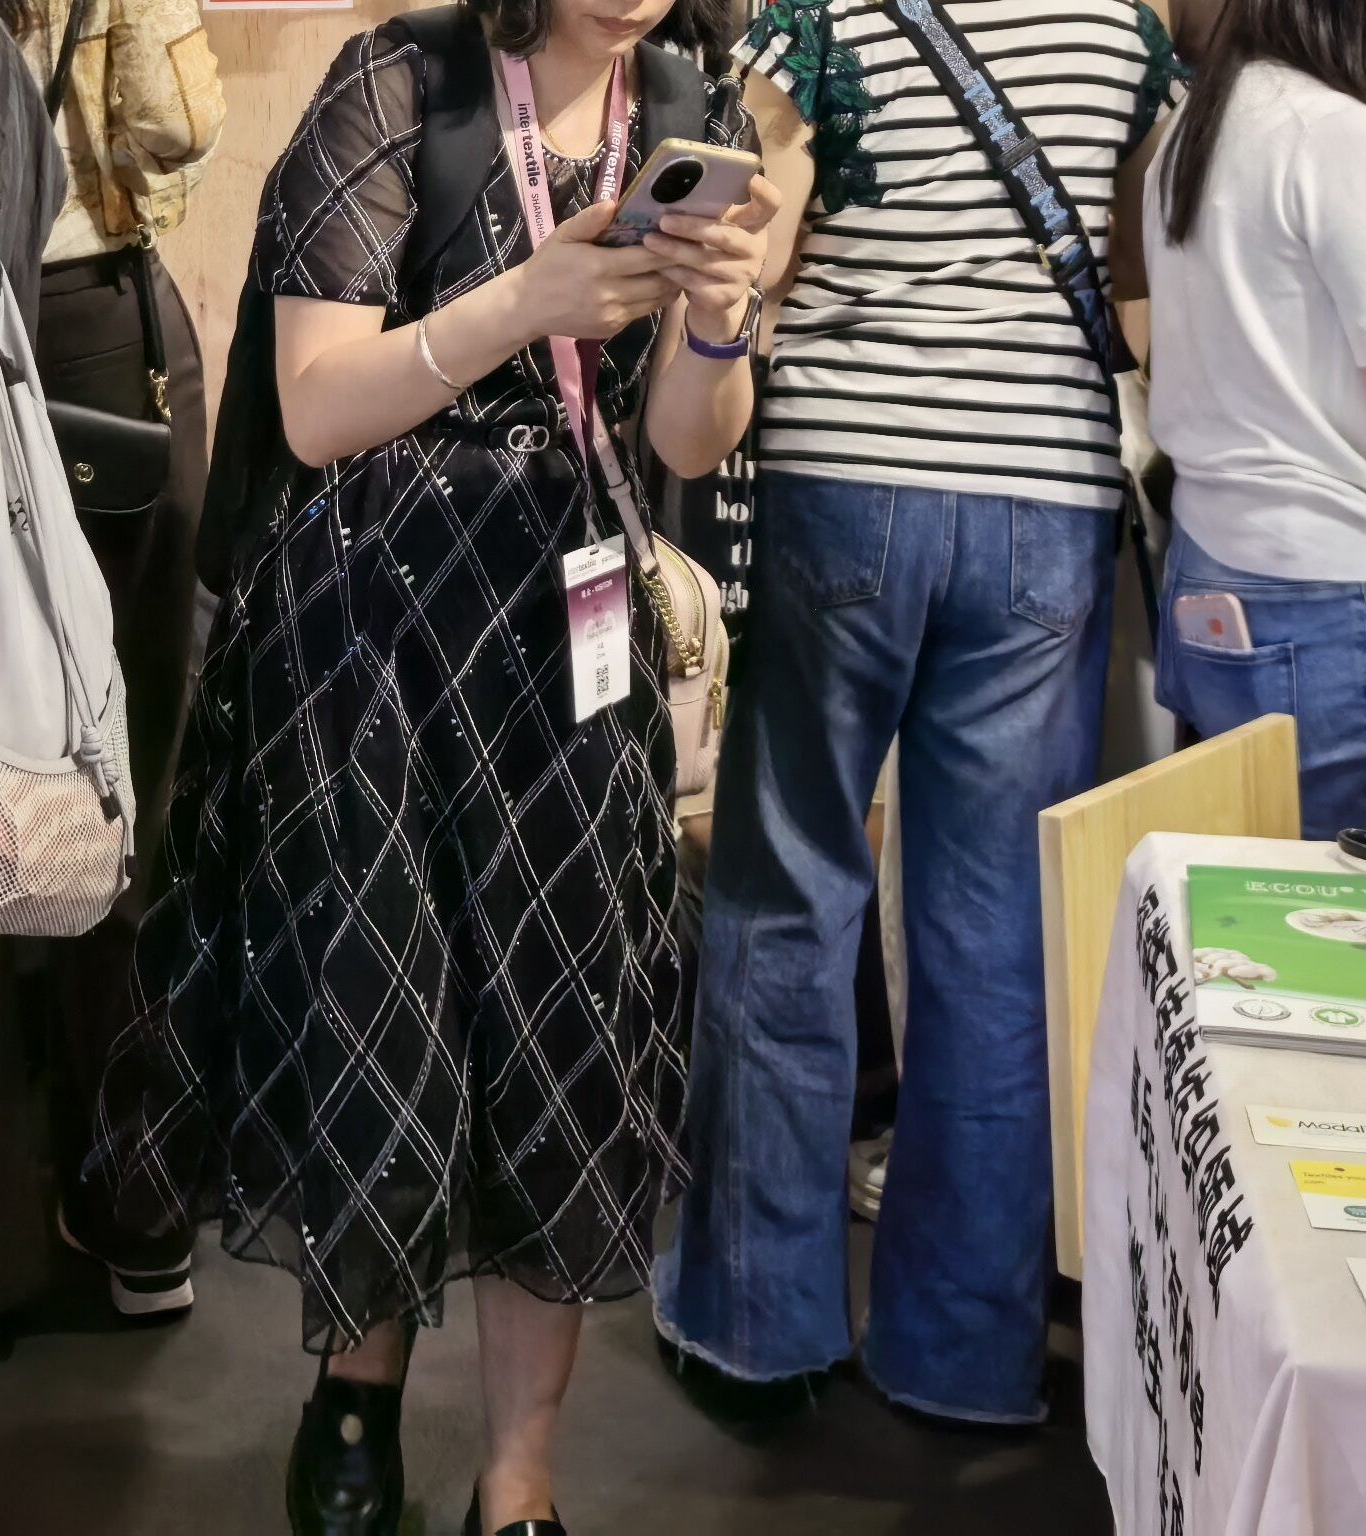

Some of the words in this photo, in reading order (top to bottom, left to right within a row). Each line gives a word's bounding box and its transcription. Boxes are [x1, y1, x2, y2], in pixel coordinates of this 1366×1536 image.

[517, 102, 541, 188] intertextile
[530, 192, 546, 239] SHANGHAI
[600, 119, 625, 201] intertextile
[1297, 1119, 1366, 1134] Modal
